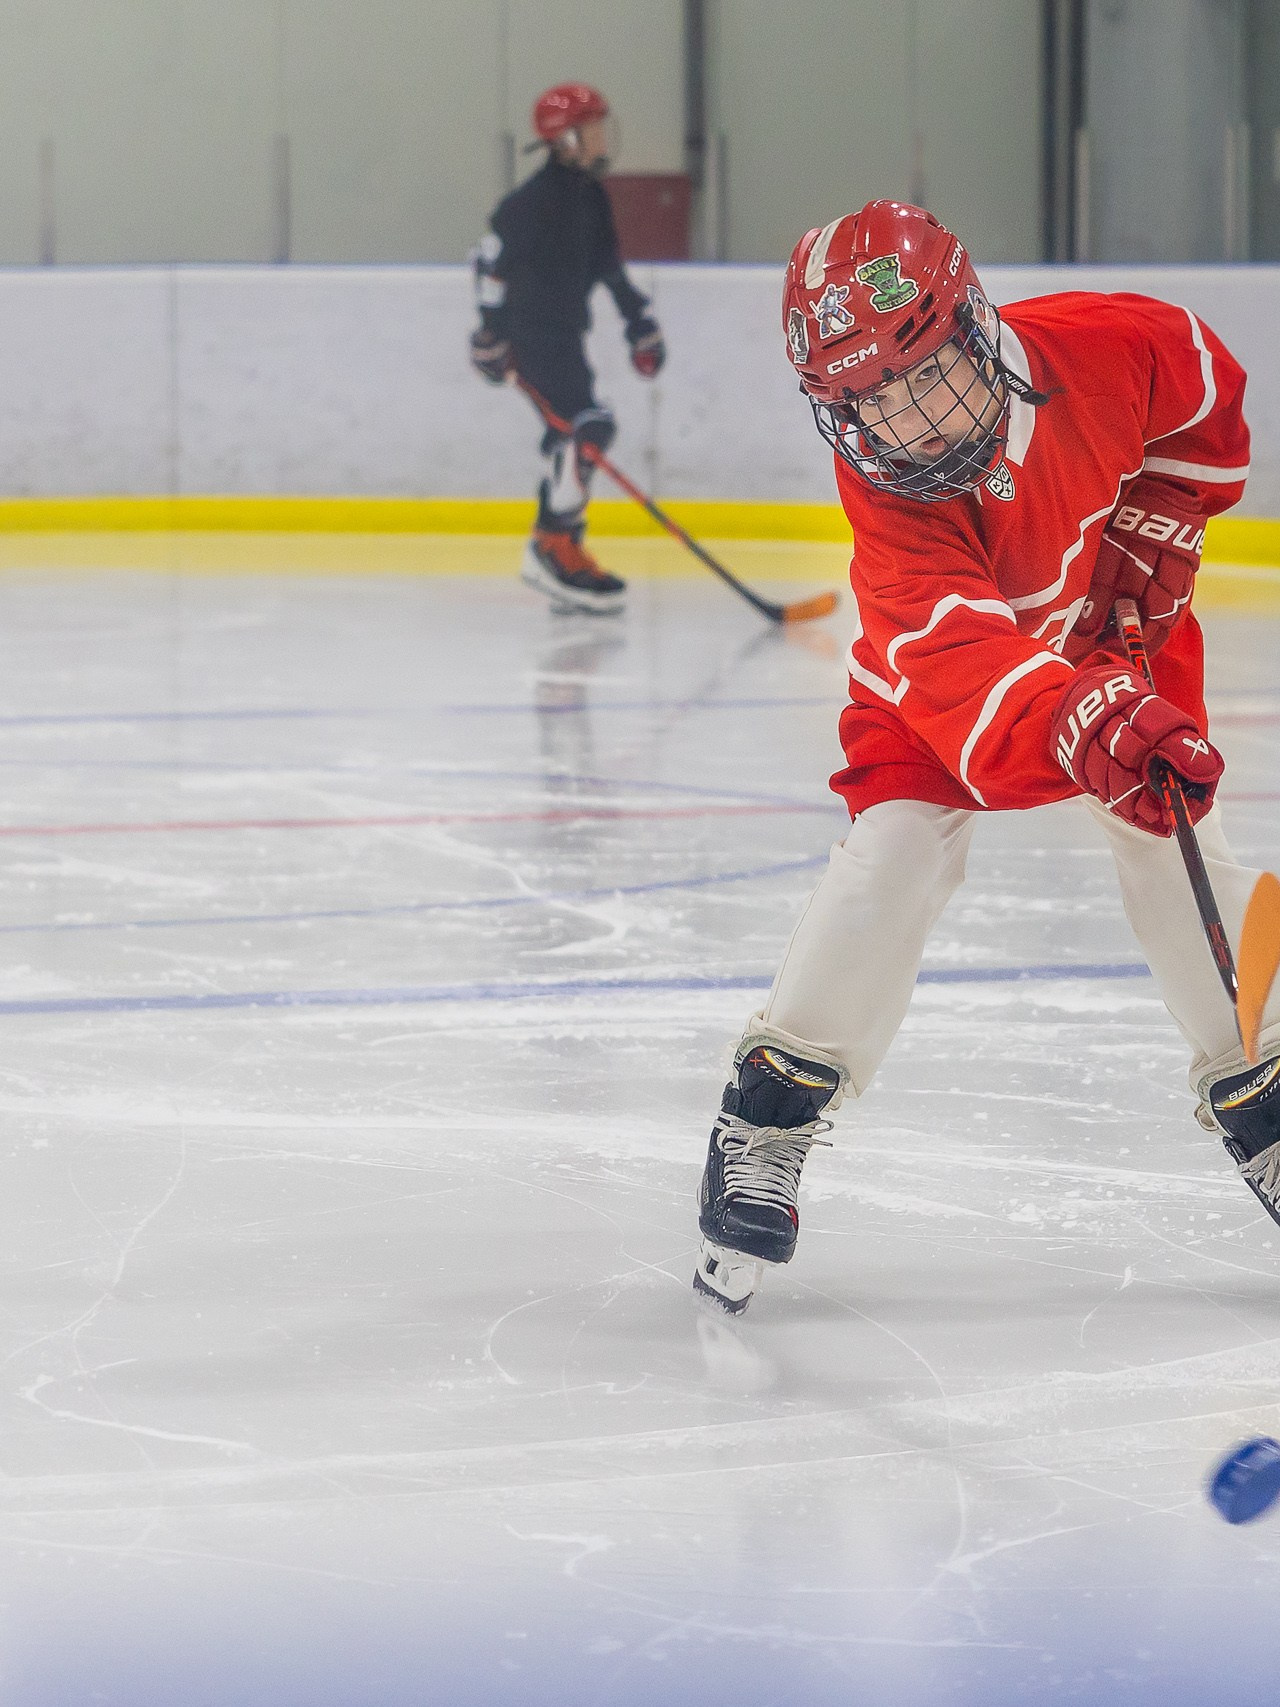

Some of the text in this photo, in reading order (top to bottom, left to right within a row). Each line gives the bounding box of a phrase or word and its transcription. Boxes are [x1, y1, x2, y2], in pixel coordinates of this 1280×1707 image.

[858, 257, 897, 281] SAINT
[949, 240, 964, 277] CCM
[826, 342, 879, 375] CCM
[772, 1054, 823, 1082] BAUER
[1228, 1064, 1273, 1101] BAUER
